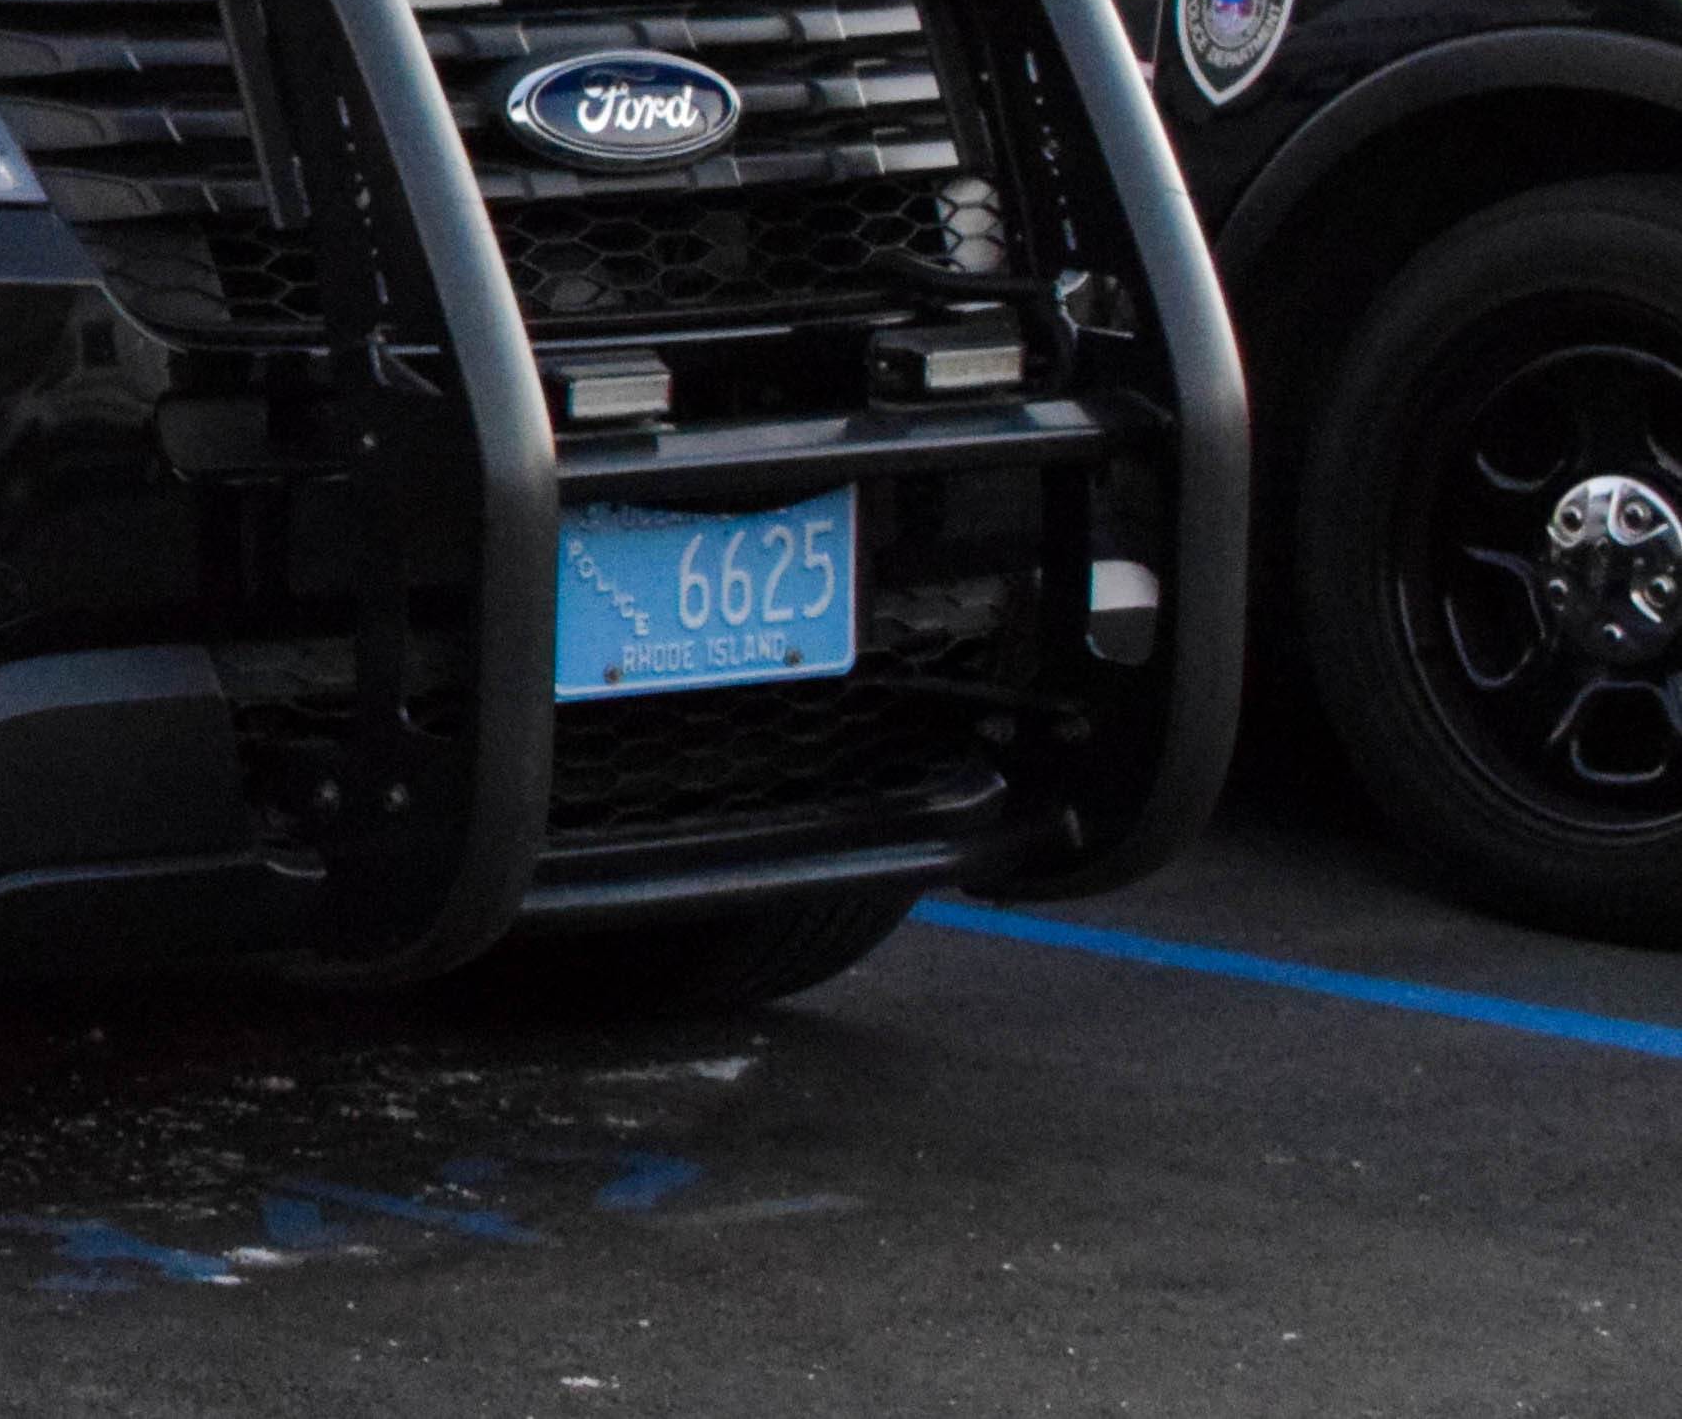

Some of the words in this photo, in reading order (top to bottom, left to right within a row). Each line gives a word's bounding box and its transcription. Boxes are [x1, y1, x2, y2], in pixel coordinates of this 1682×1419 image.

[576, 80, 700, 134] Ford
[677, 520, 835, 630] 6625
[621, 640, 695, 672] RHODE
[706, 629, 786, 667] ISLAND
